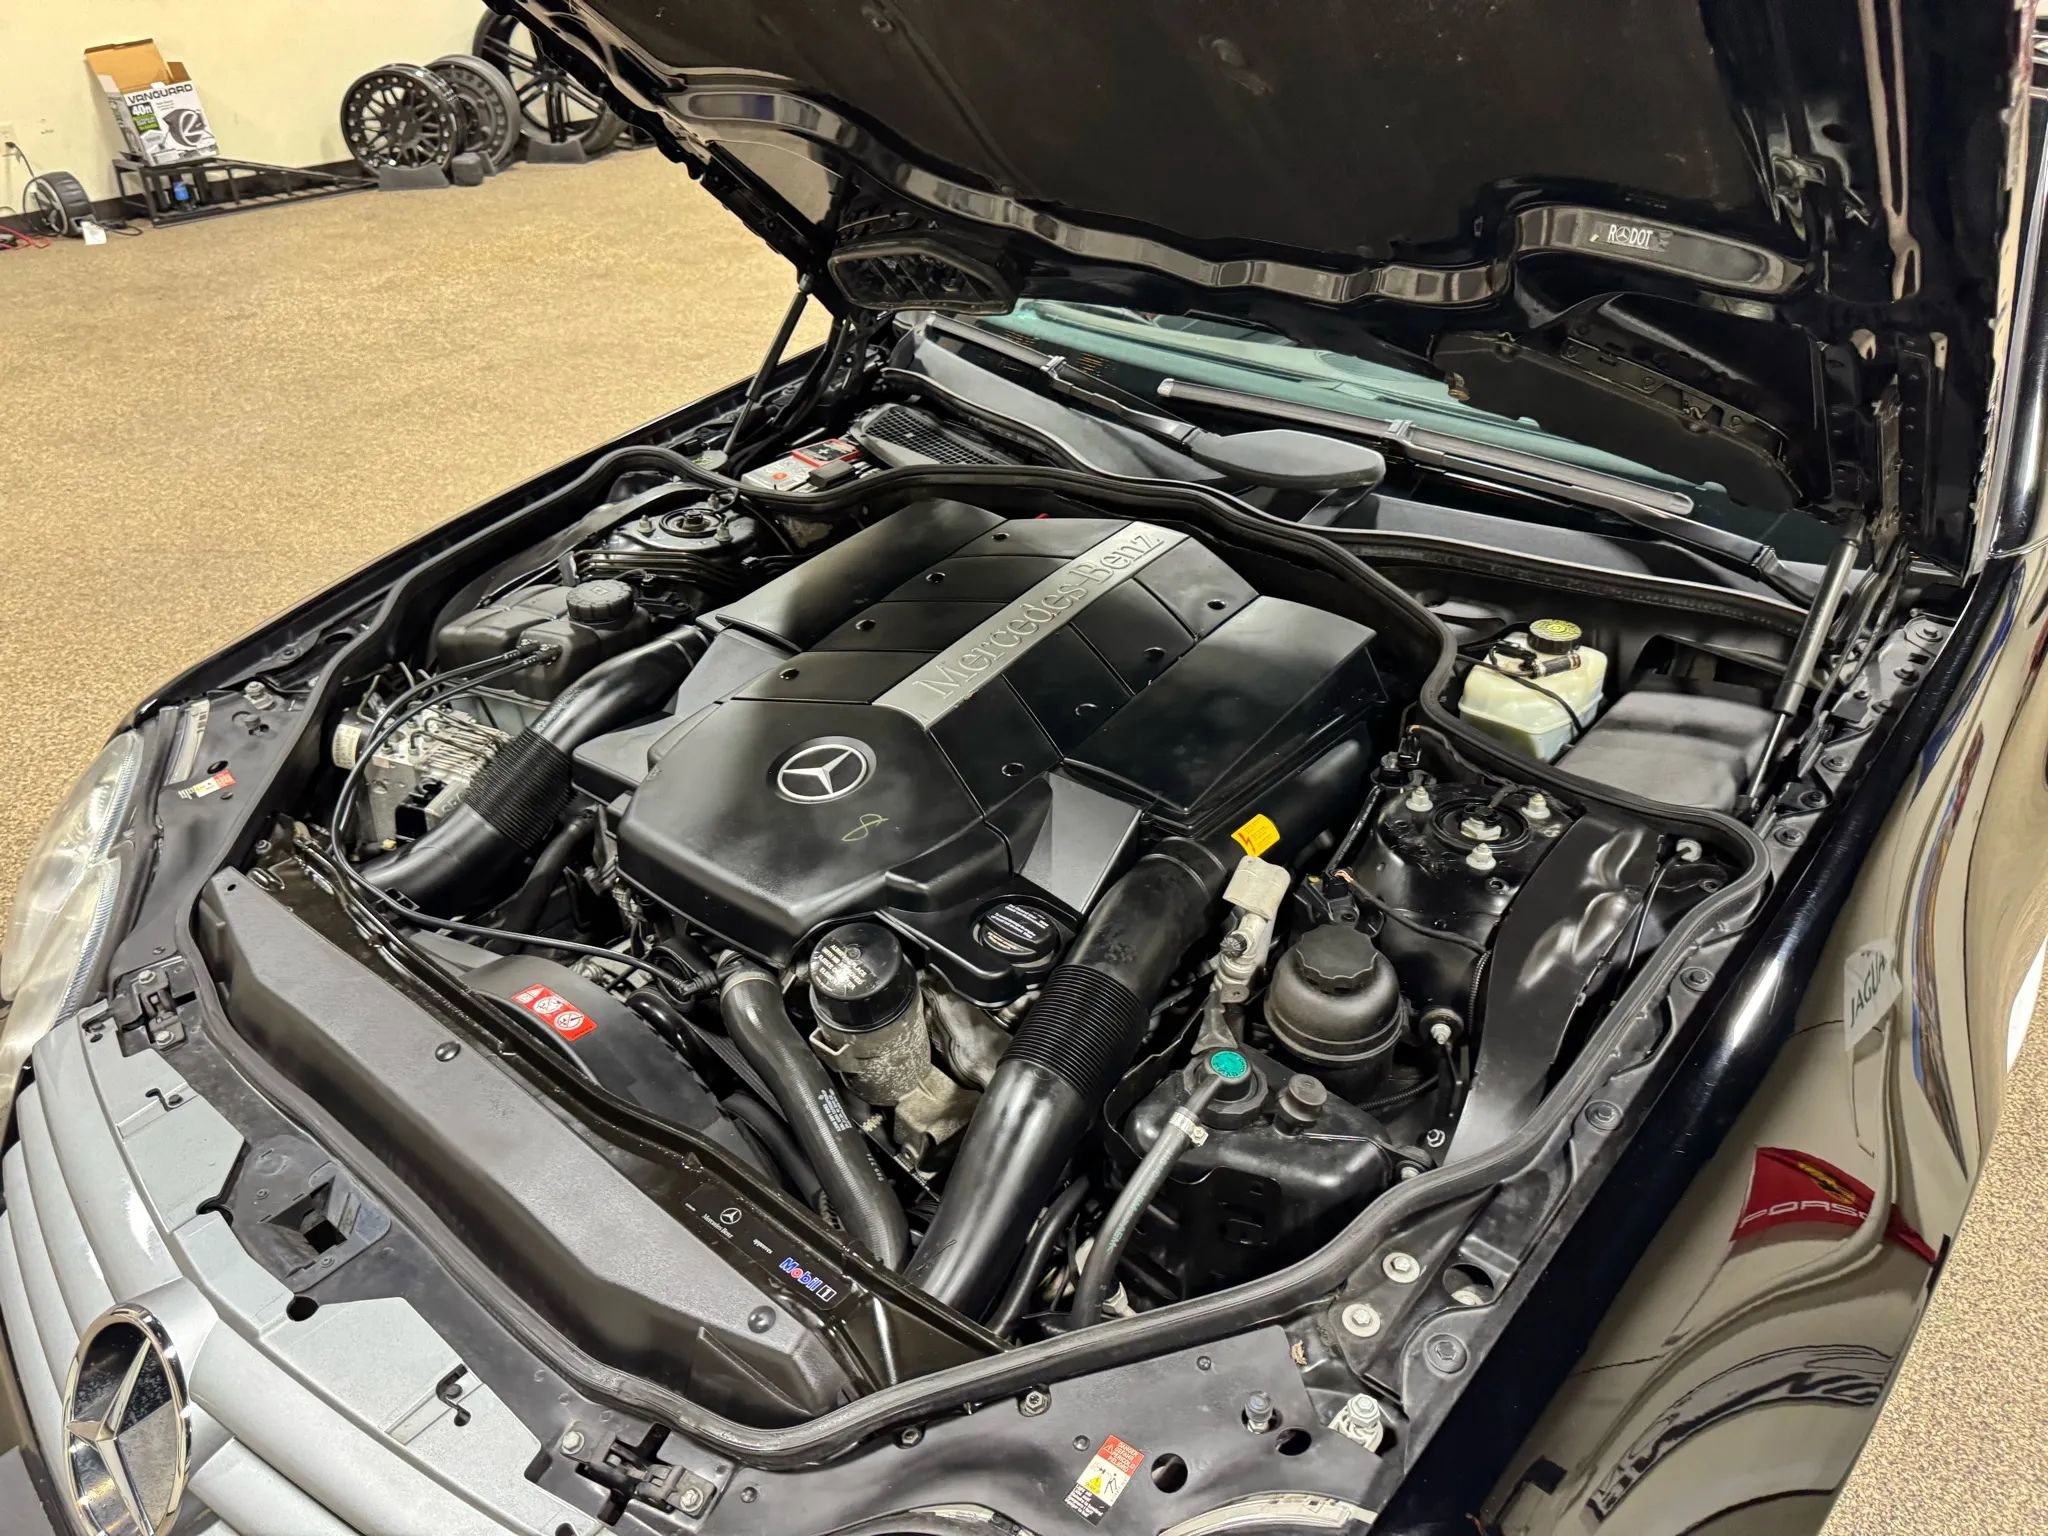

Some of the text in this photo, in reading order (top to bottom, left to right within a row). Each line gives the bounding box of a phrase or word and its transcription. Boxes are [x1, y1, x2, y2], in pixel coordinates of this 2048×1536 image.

[128, 83, 193, 103] VANGUARD
[911, 533, 1165, 700] Mercedes-Benz
[1849, 951, 1888, 1028] JAGUA
[779, 1257, 823, 1292] Mobil
